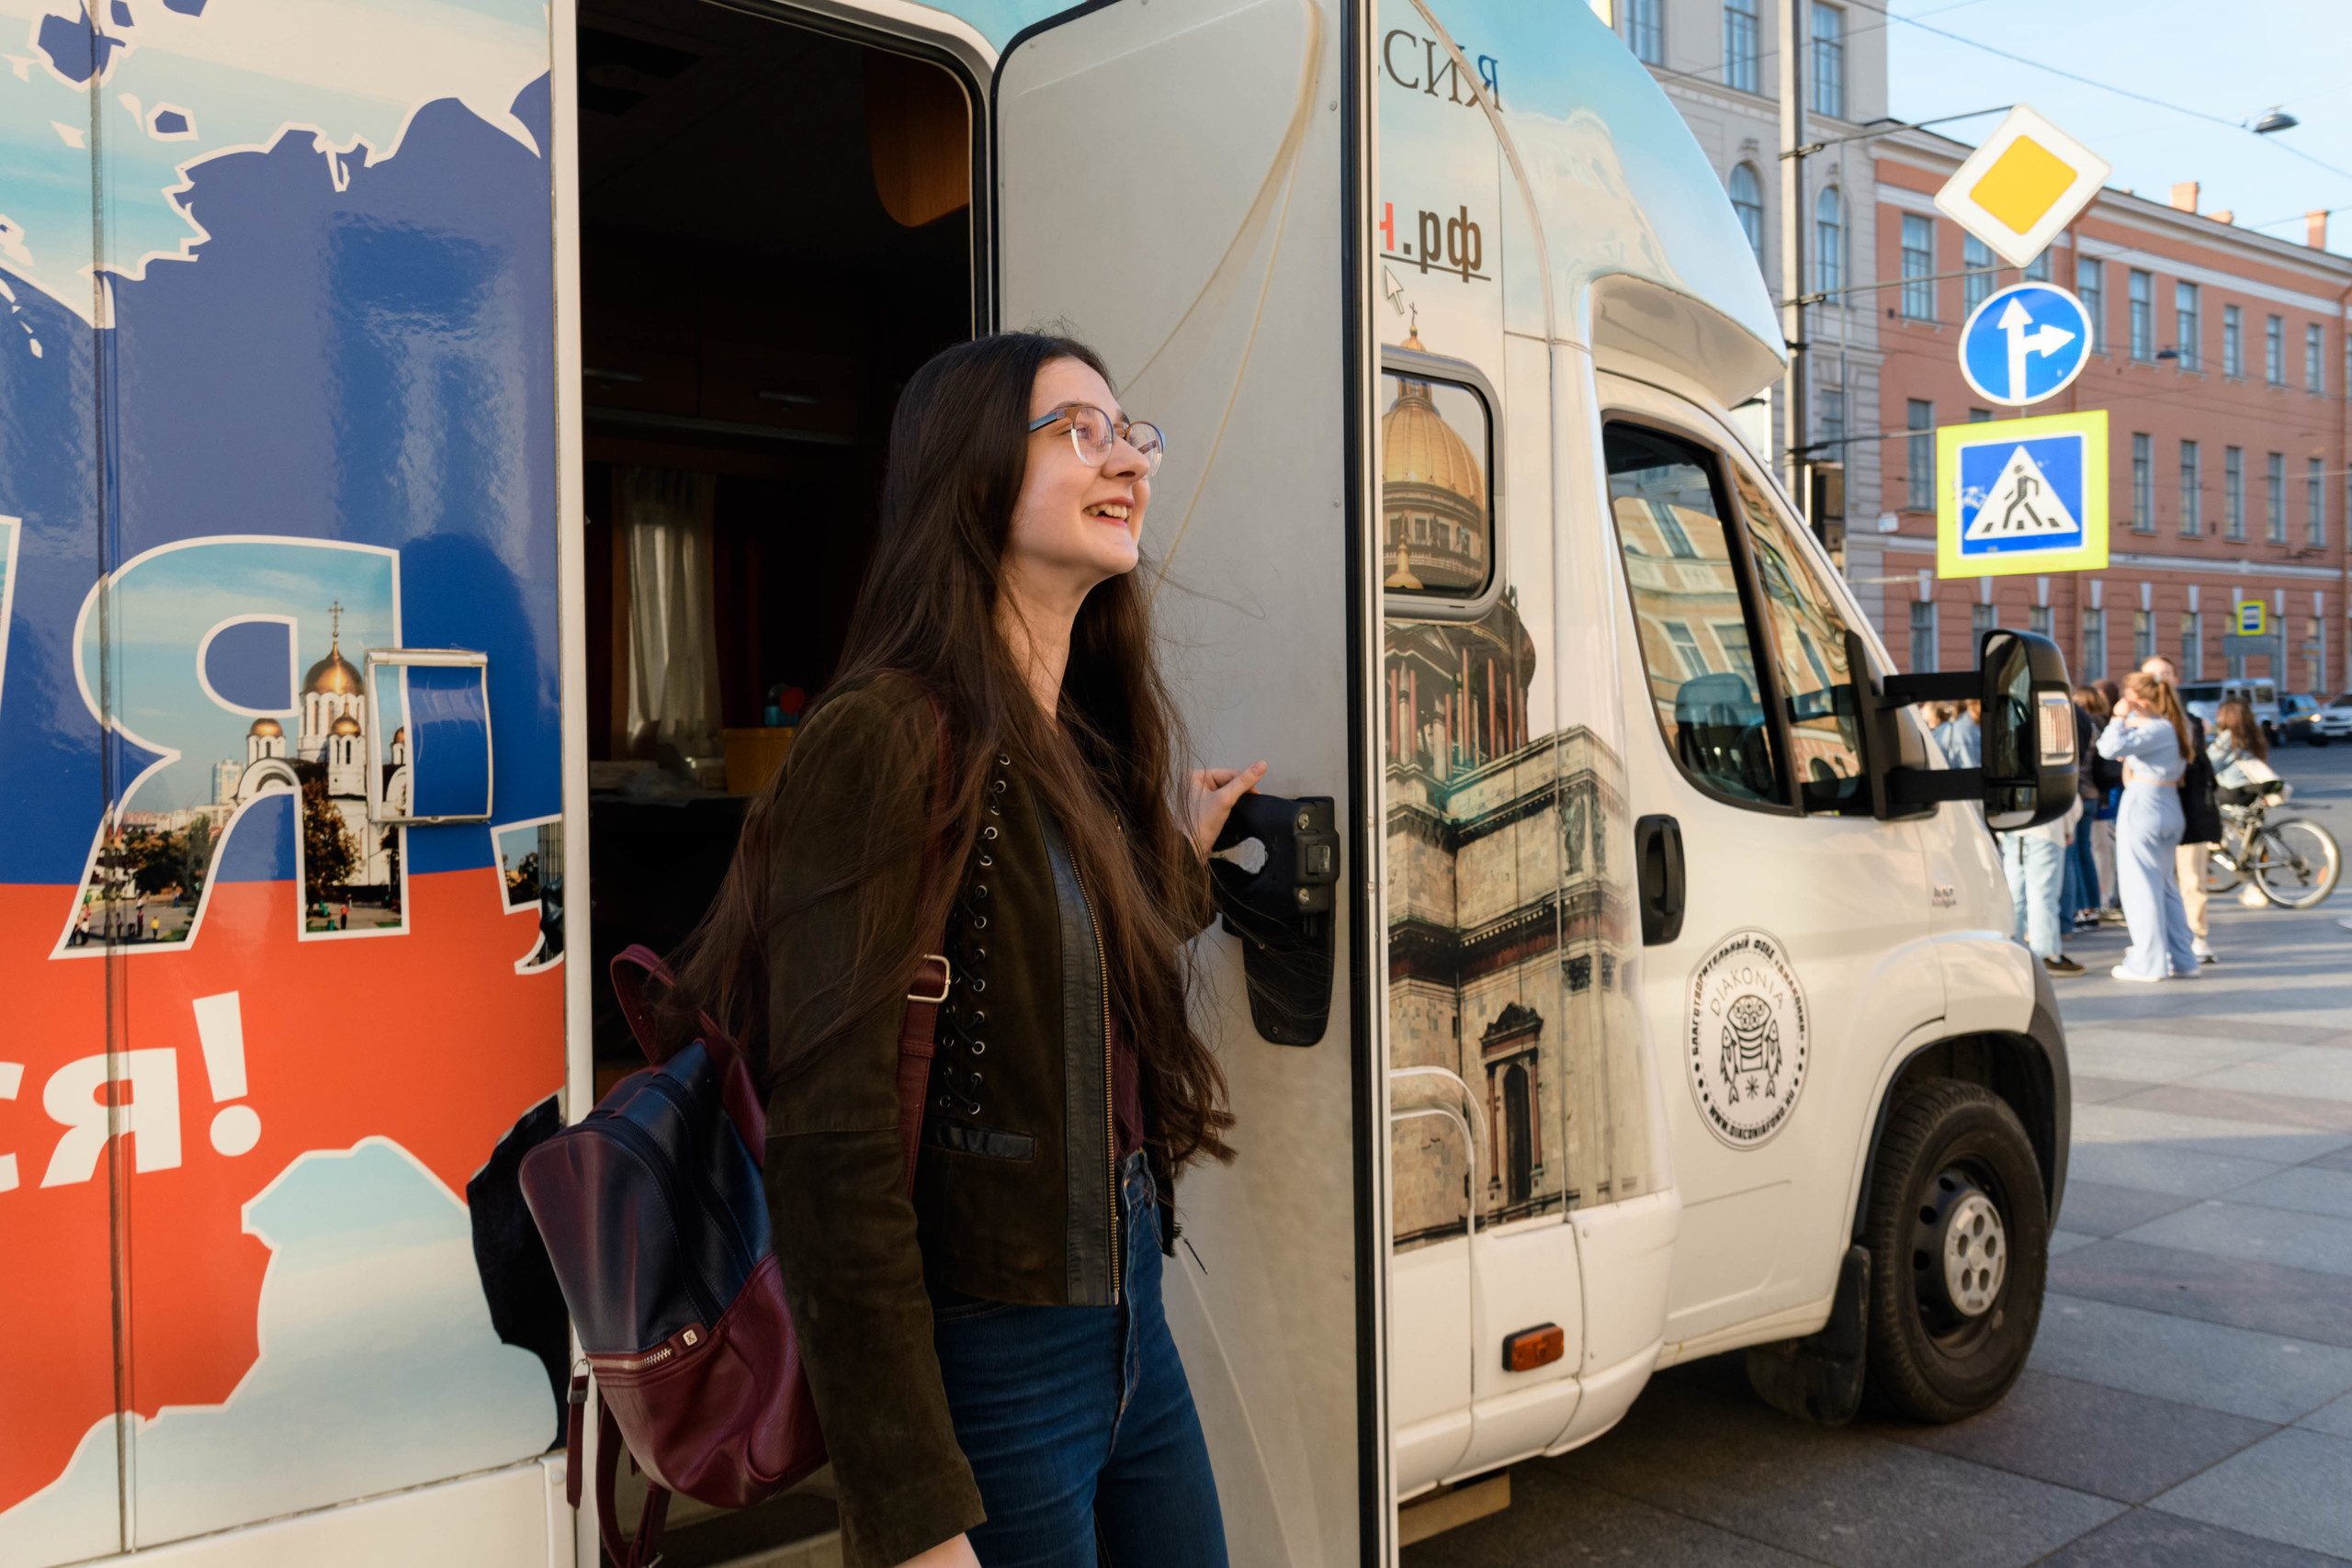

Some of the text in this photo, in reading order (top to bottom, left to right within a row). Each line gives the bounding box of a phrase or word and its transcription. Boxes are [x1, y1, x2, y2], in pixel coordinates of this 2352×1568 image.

[1378, 29, 1503, 113] СИЯ
[1691, 934, 1749, 1055] БЛАГОТВОРИТЕЛЬНЫЙ
[1710, 966, 1782, 1016] DIAKONIA
